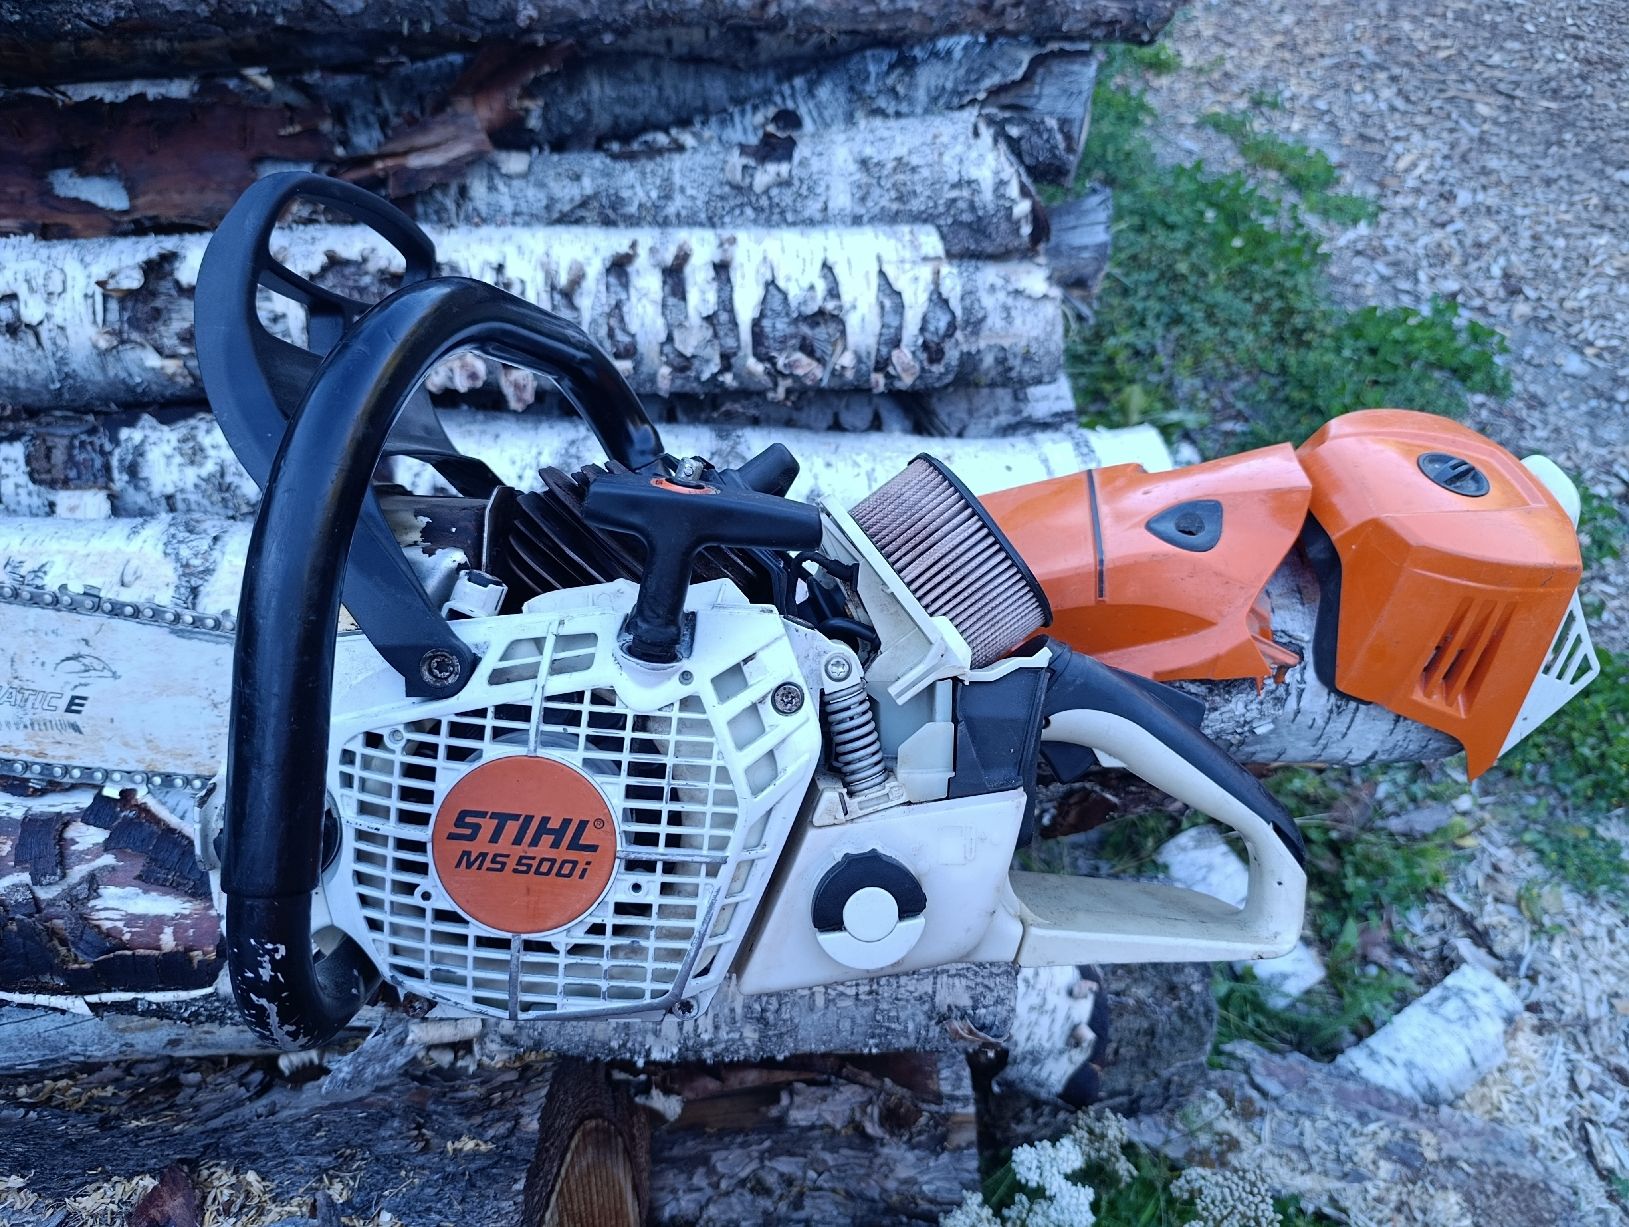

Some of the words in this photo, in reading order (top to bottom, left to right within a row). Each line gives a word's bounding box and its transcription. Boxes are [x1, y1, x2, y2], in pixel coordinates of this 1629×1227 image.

[0, 686, 64, 711] ATIC
[64, 694, 90, 715] E
[454, 850, 511, 873] MS
[512, 855, 592, 880] 500i
